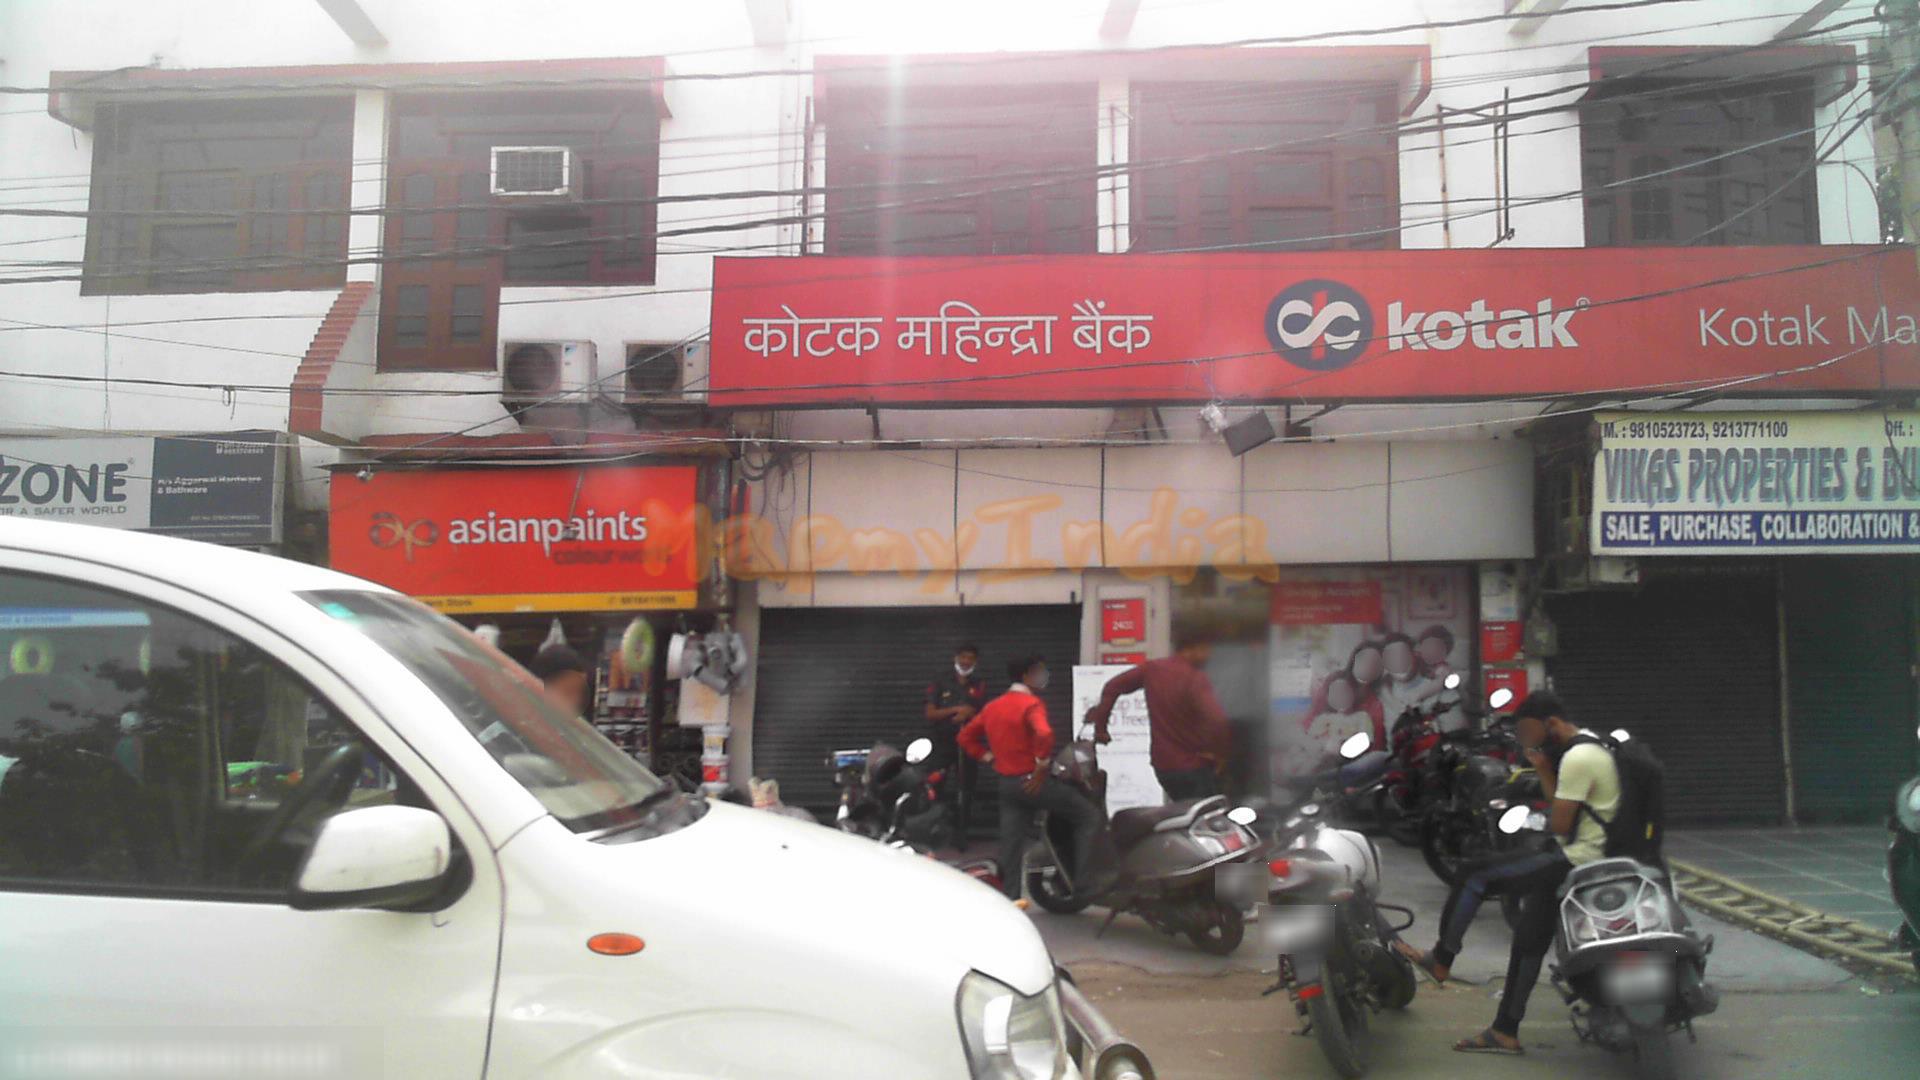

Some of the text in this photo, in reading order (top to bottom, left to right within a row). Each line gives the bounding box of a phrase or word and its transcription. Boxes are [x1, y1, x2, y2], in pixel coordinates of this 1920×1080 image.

[742, 299, 1153, 363] कोटक महिन्द्रा बैंक
[1388, 298, 1579, 350] kotak
[1699, 304, 1920, 346] Kotak Ma
[1630, 421, 1709, 440] 9810523723,
[1713, 421, 1788, 438] 9213771100
[165, 486, 208, 494] Bathware
[1604, 448, 1680, 507] VIKAS
[1689, 448, 1848, 507] PROPERTIES
[1855, 447, 1874, 501] &
[20, 507, 28, 515] A
[34, 506, 75, 515] SAFER
[81, 505, 127, 514] WORLD
[1606, 514, 1656, 545] SALE,
[1659, 514, 1757, 544] PURCHASE,
[1761, 512, 1903, 540] COLLABORATION
[448, 510, 647, 557] asianpaints
